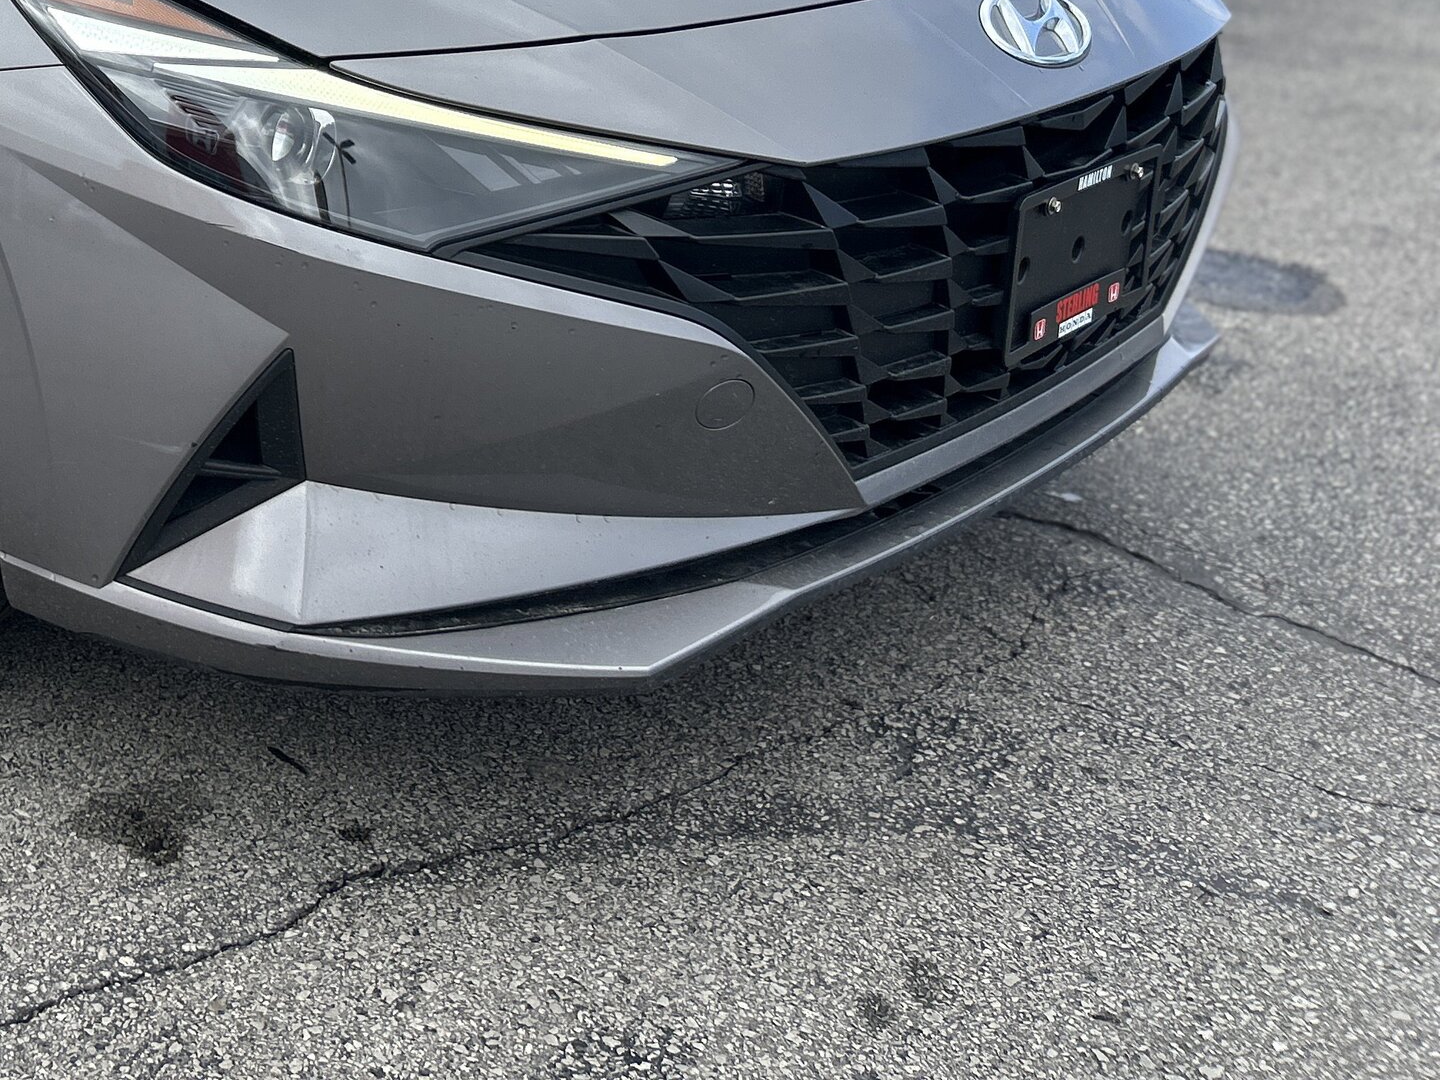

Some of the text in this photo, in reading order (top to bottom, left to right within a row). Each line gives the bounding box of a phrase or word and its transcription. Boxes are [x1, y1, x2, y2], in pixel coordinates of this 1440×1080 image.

[1078, 165, 1113, 191] HAMILTON
[1056, 283, 1100, 325] STERLING
[1059, 311, 1092, 334] HONDA
